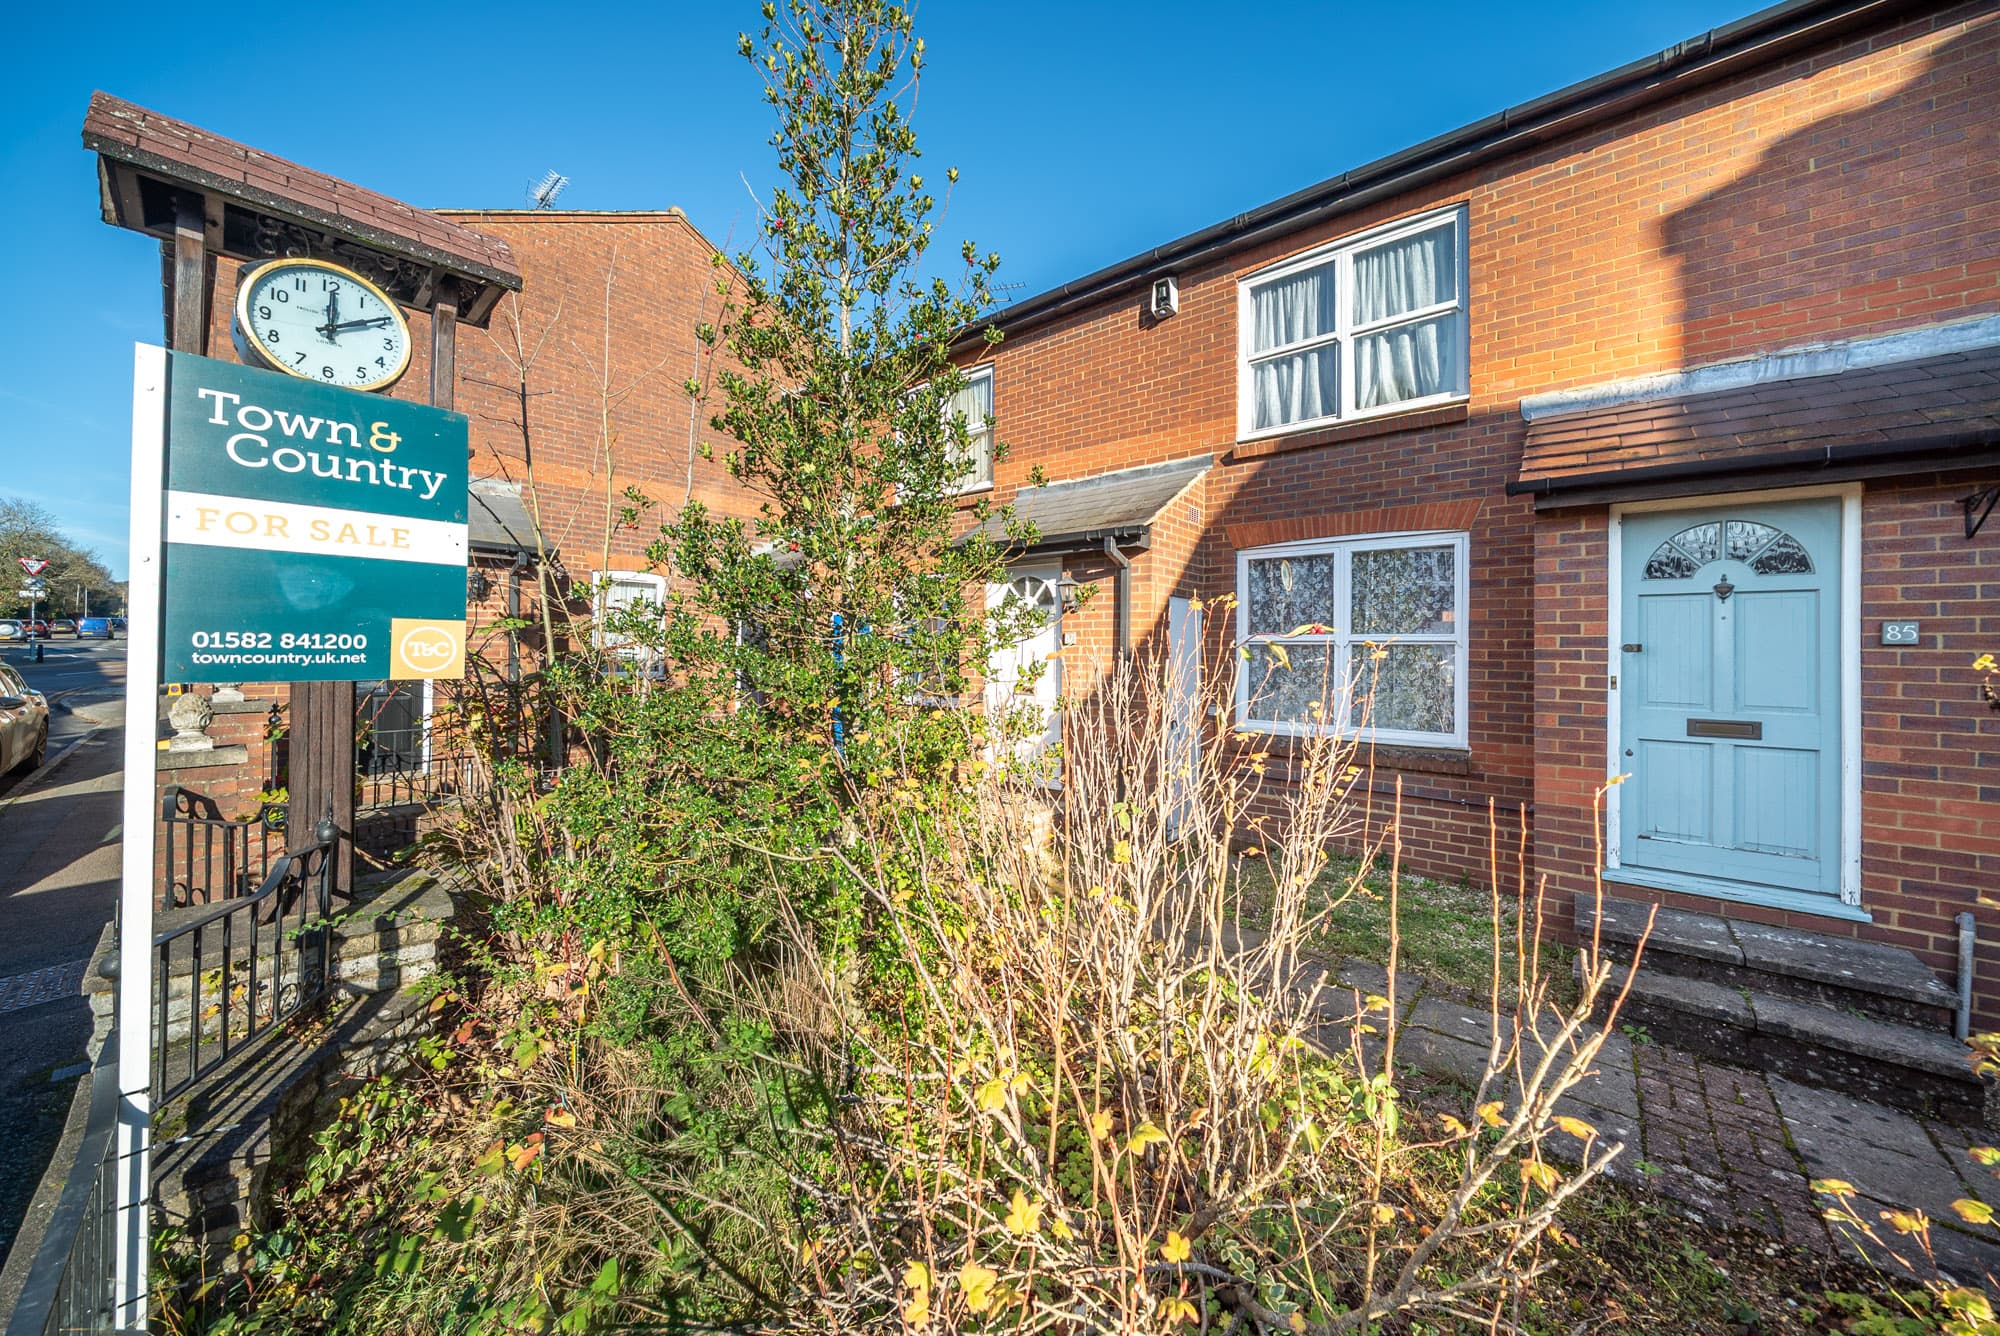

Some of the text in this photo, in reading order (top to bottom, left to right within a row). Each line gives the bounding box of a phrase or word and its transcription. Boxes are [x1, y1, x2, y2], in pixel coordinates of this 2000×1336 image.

[295, 278, 306, 292] 11
[322, 279, 340, 295] 12
[271, 287, 288, 303] 10
[360, 296, 364, 309] 1
[259, 306, 271, 320] 9
[268, 329, 280, 343] 8
[383, 338, 393, 351] 3
[295, 351, 306, 365] 7
[375, 356, 386, 368] 4
[322, 366, 334, 379] 6
[356, 366, 367, 379] 5
[198, 387, 402, 453] Town &
[226, 433, 447, 500] Country
[195, 507, 411, 549] FOR SALE
[1886, 625, 1917, 640] 85
[191, 631, 367, 649] 01582 841200
[408, 641, 449, 657] T&C
[191, 652, 367, 667] towncountry.uk.net
